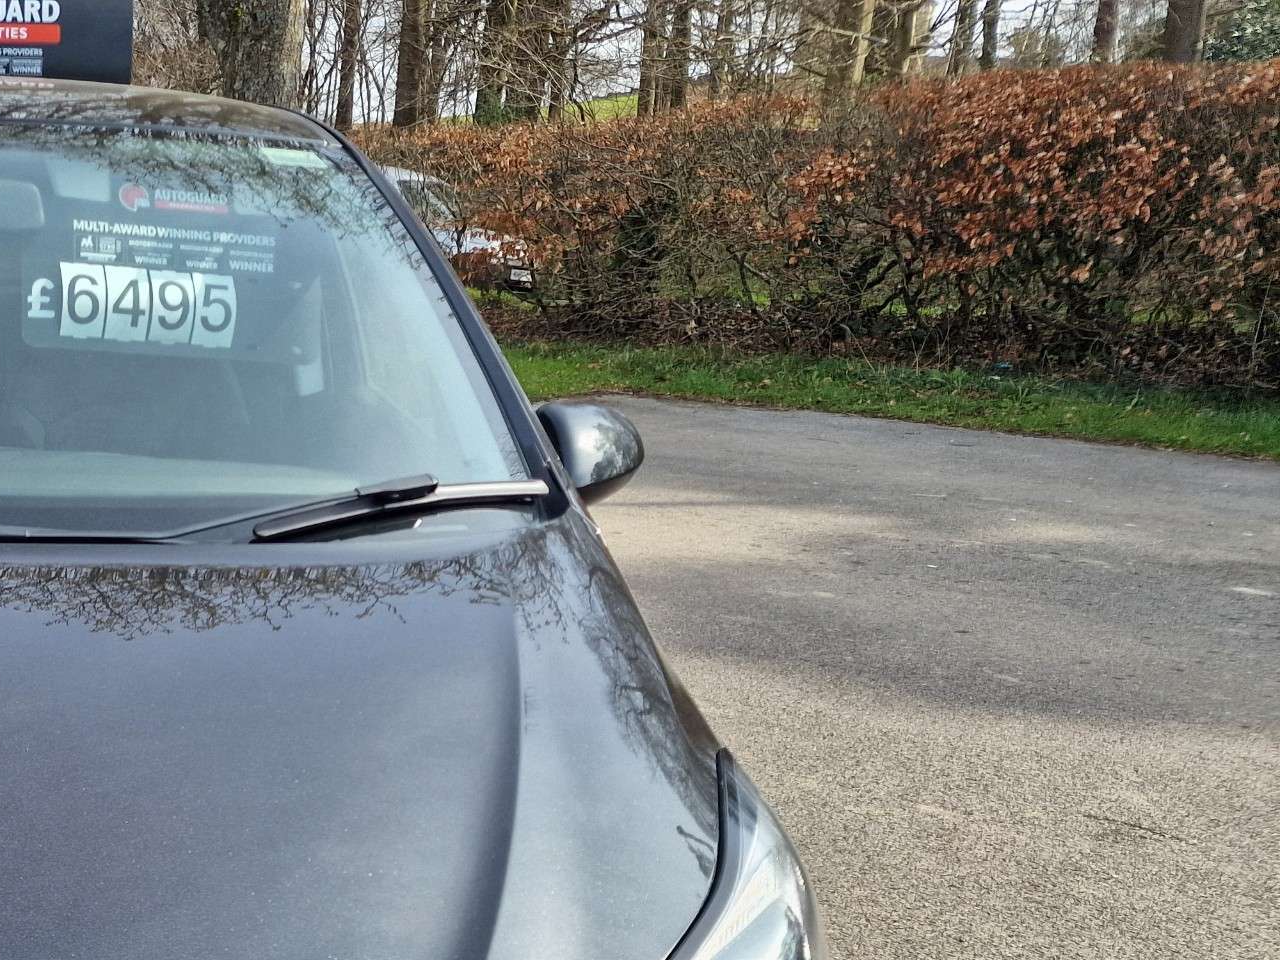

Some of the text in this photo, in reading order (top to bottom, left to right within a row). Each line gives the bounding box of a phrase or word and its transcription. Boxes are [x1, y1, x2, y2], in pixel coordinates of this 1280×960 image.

[3, 48, 43, 57] PROVIDERS
[73, 219, 276, 247] MULTI-AWARD WINNING PROVIDERS
[229, 259, 274, 273] WINNER
